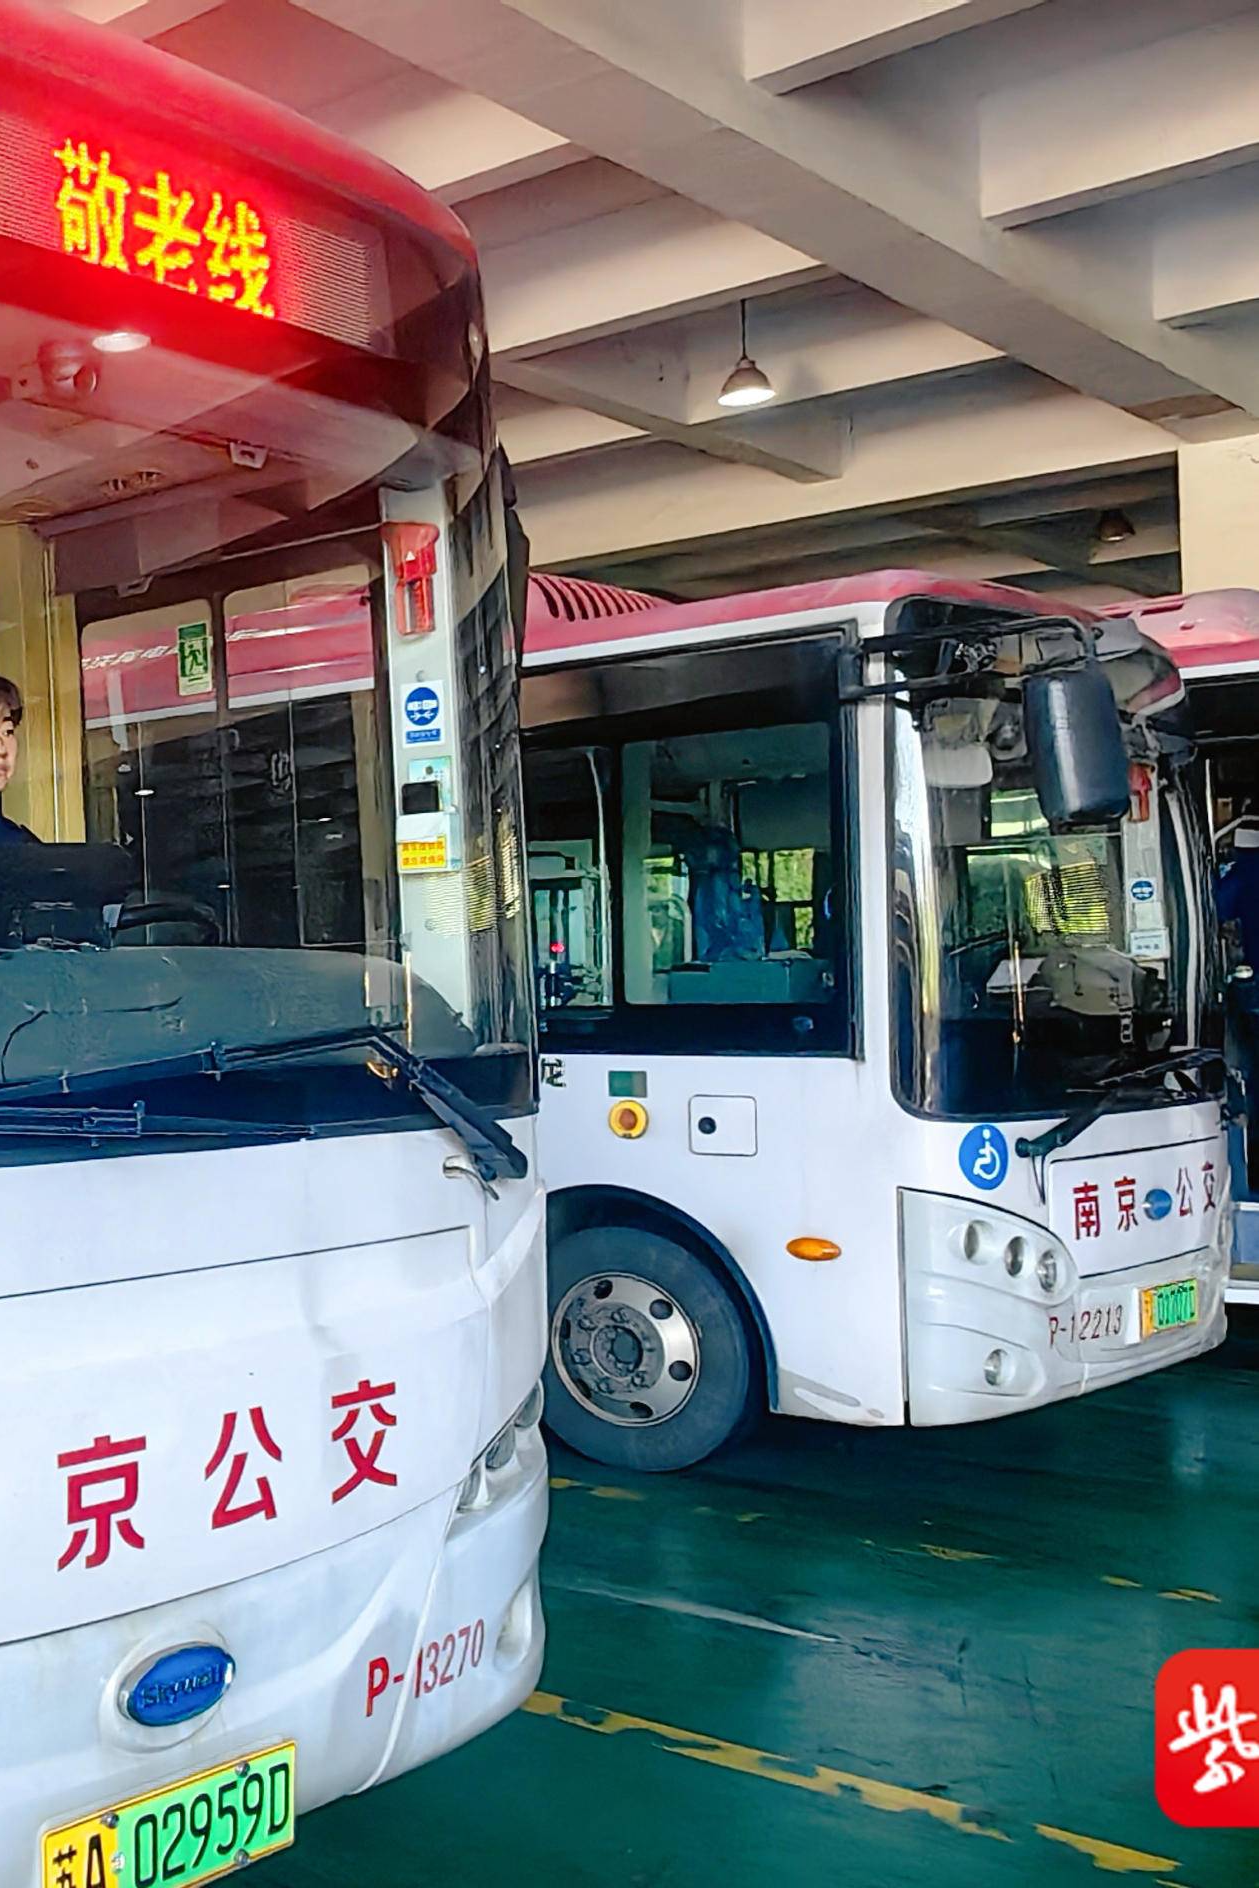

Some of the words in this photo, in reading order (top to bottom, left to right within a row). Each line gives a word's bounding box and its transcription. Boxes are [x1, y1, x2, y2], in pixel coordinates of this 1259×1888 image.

[54, 138, 276, 318] 敬老线
[1072, 1160, 1217, 1241] 南京公交
[1048, 1304, 1123, 1348] P-12213
[365, 1618, 485, 1718] P-13270
